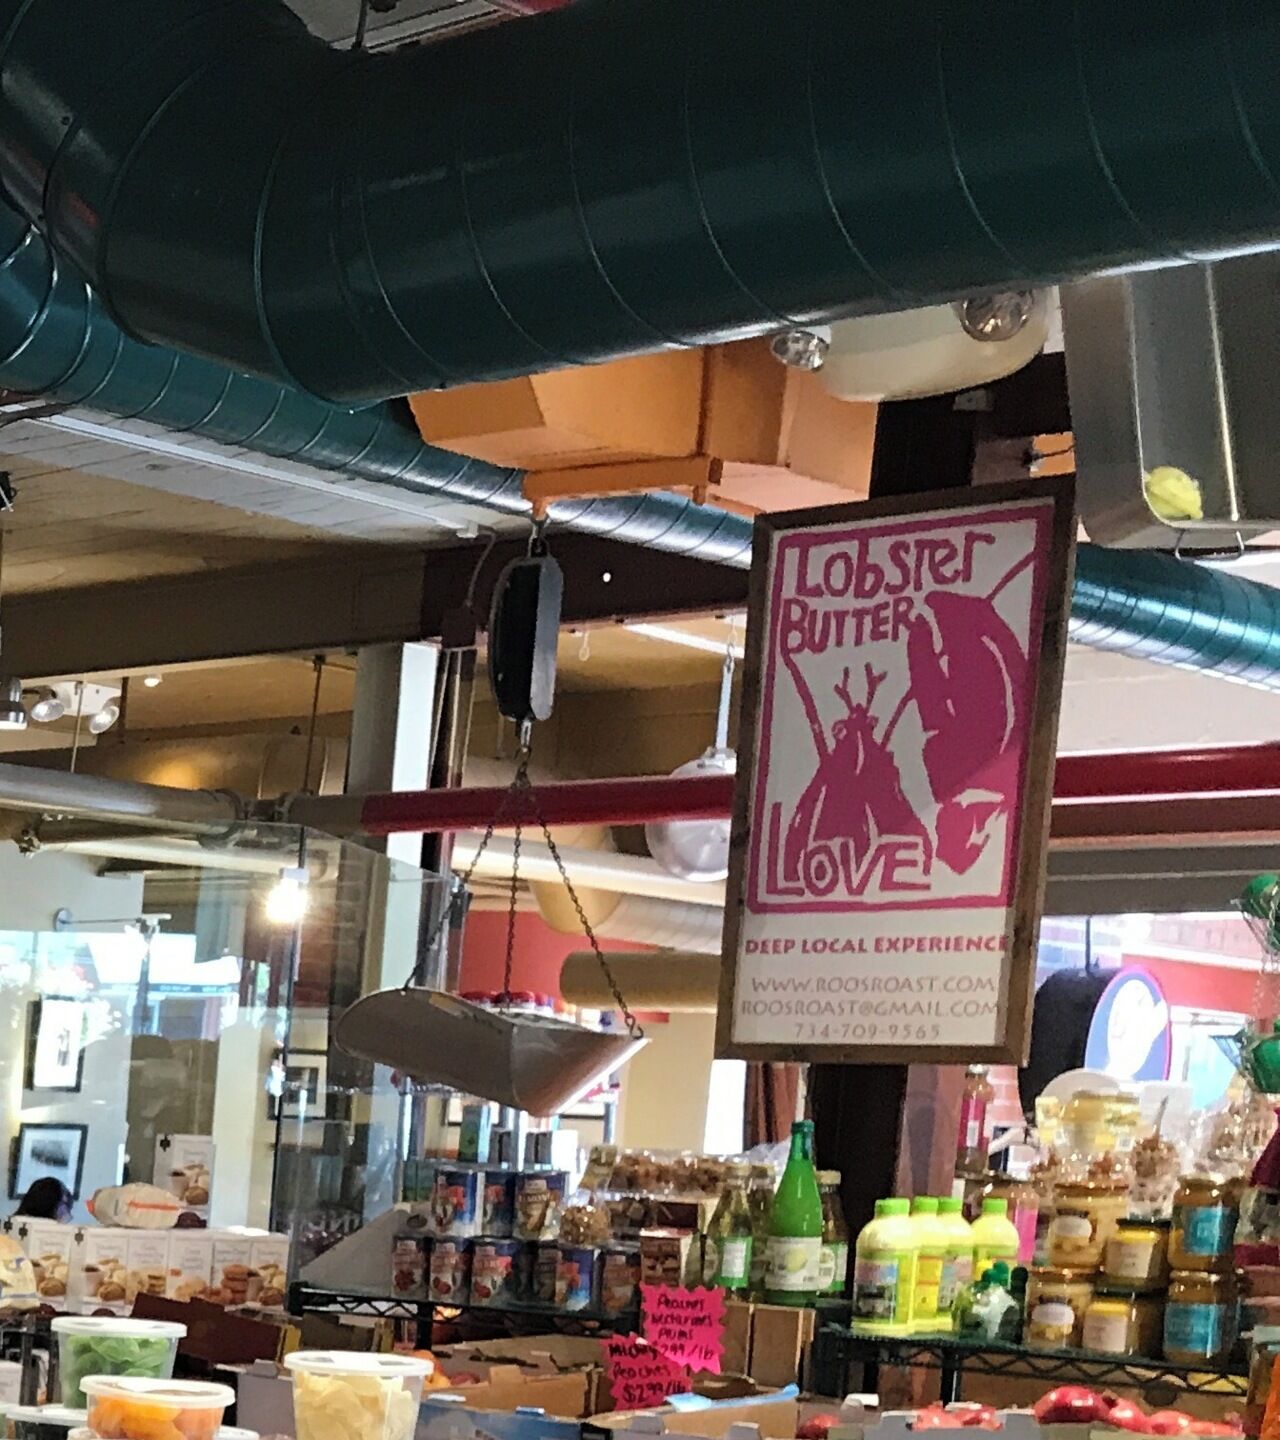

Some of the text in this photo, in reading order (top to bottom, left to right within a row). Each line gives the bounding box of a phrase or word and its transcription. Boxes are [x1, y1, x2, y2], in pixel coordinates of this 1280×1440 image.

[784, 596, 915, 655] BUTTER
[766, 802, 933, 897] LOVE
[745, 936, 1009, 955] DEEP LOCAL EXPERIENCE
[751, 976, 996, 994] WWW.ROOSROAST.COM
[742, 1000, 999, 1018] ROOSROAST@GMAIL.COM
[794, 1022, 942, 1040] 734-709-9565
